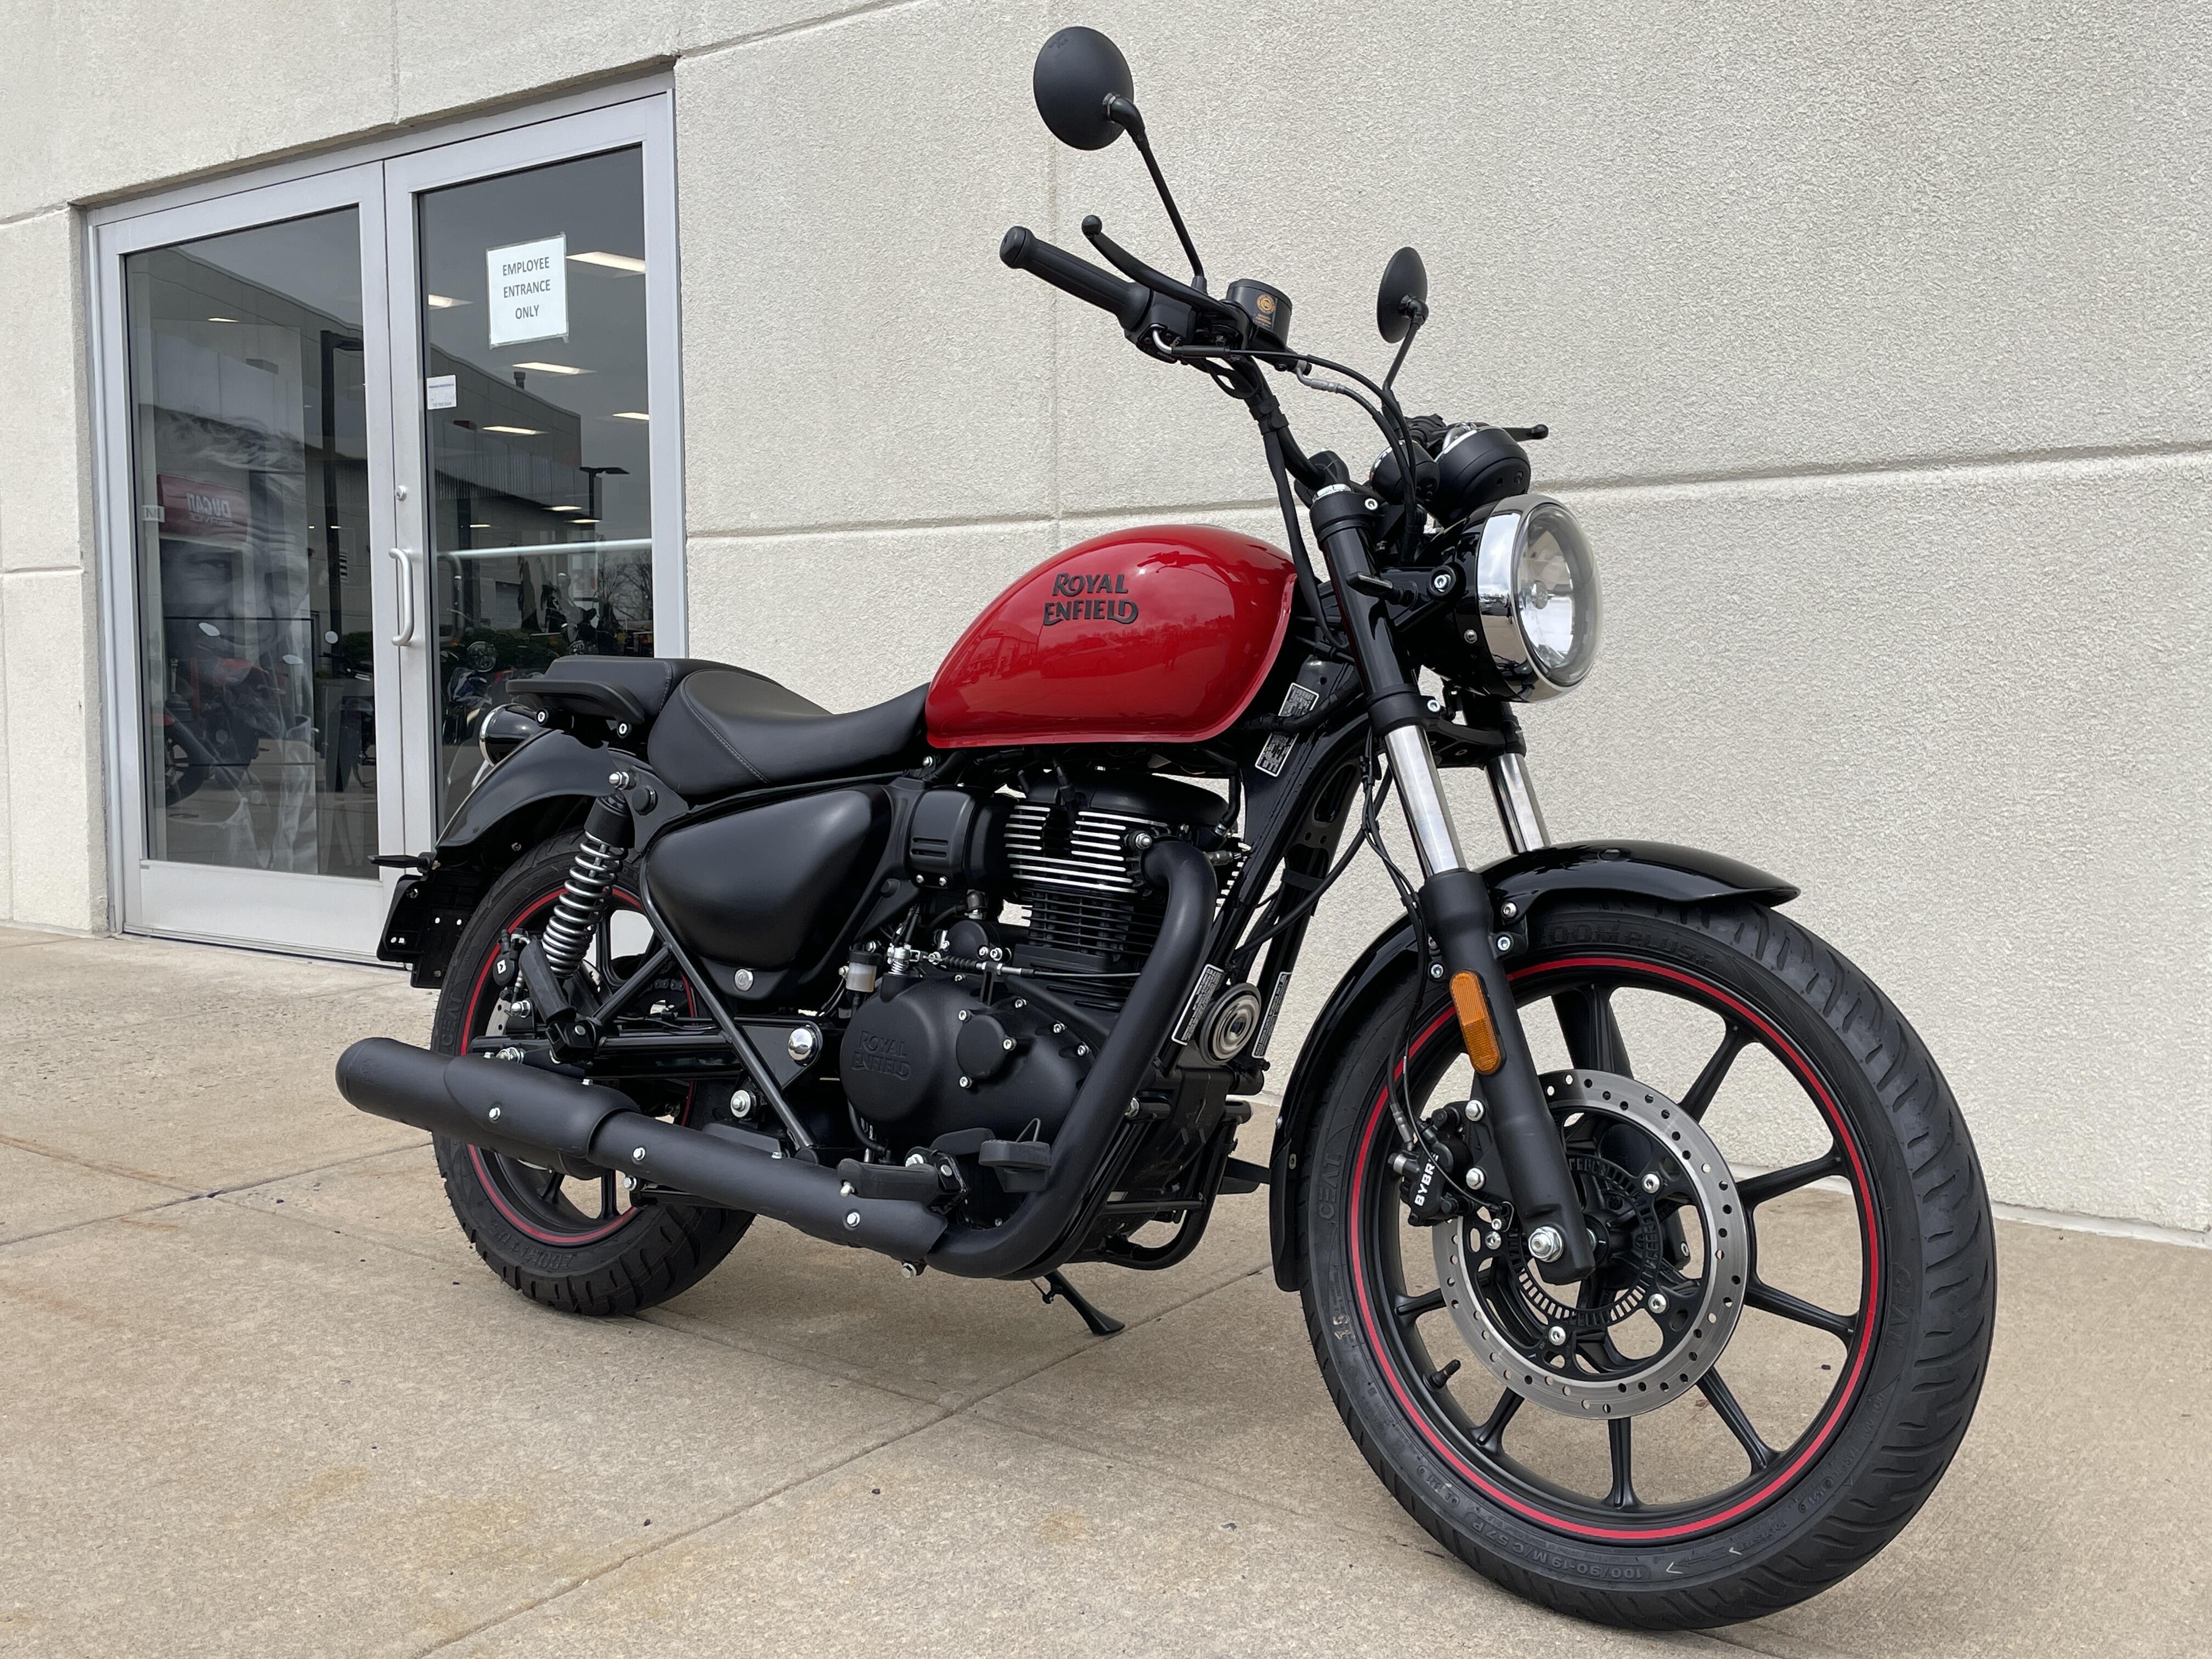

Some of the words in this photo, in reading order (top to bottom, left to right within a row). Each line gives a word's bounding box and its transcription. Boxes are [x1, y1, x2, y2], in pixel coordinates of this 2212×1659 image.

[503, 256, 550, 276] EMPLOYEE
[504, 279, 551, 298] ENTRANCE
[515, 304, 540, 319] ONLY
[1052, 573, 1128, 597] ROYAL
[1043, 599, 1139, 626] ENFIELD
[857, 1029, 907, 1058] ROYAL
[851, 1051, 912, 1081] ENFIELD
[1318, 1153, 1341, 1220] CEAT
[1512, 1541, 1548, 1563] M/C
[1551, 1557, 1643, 1579] 100/90-19
